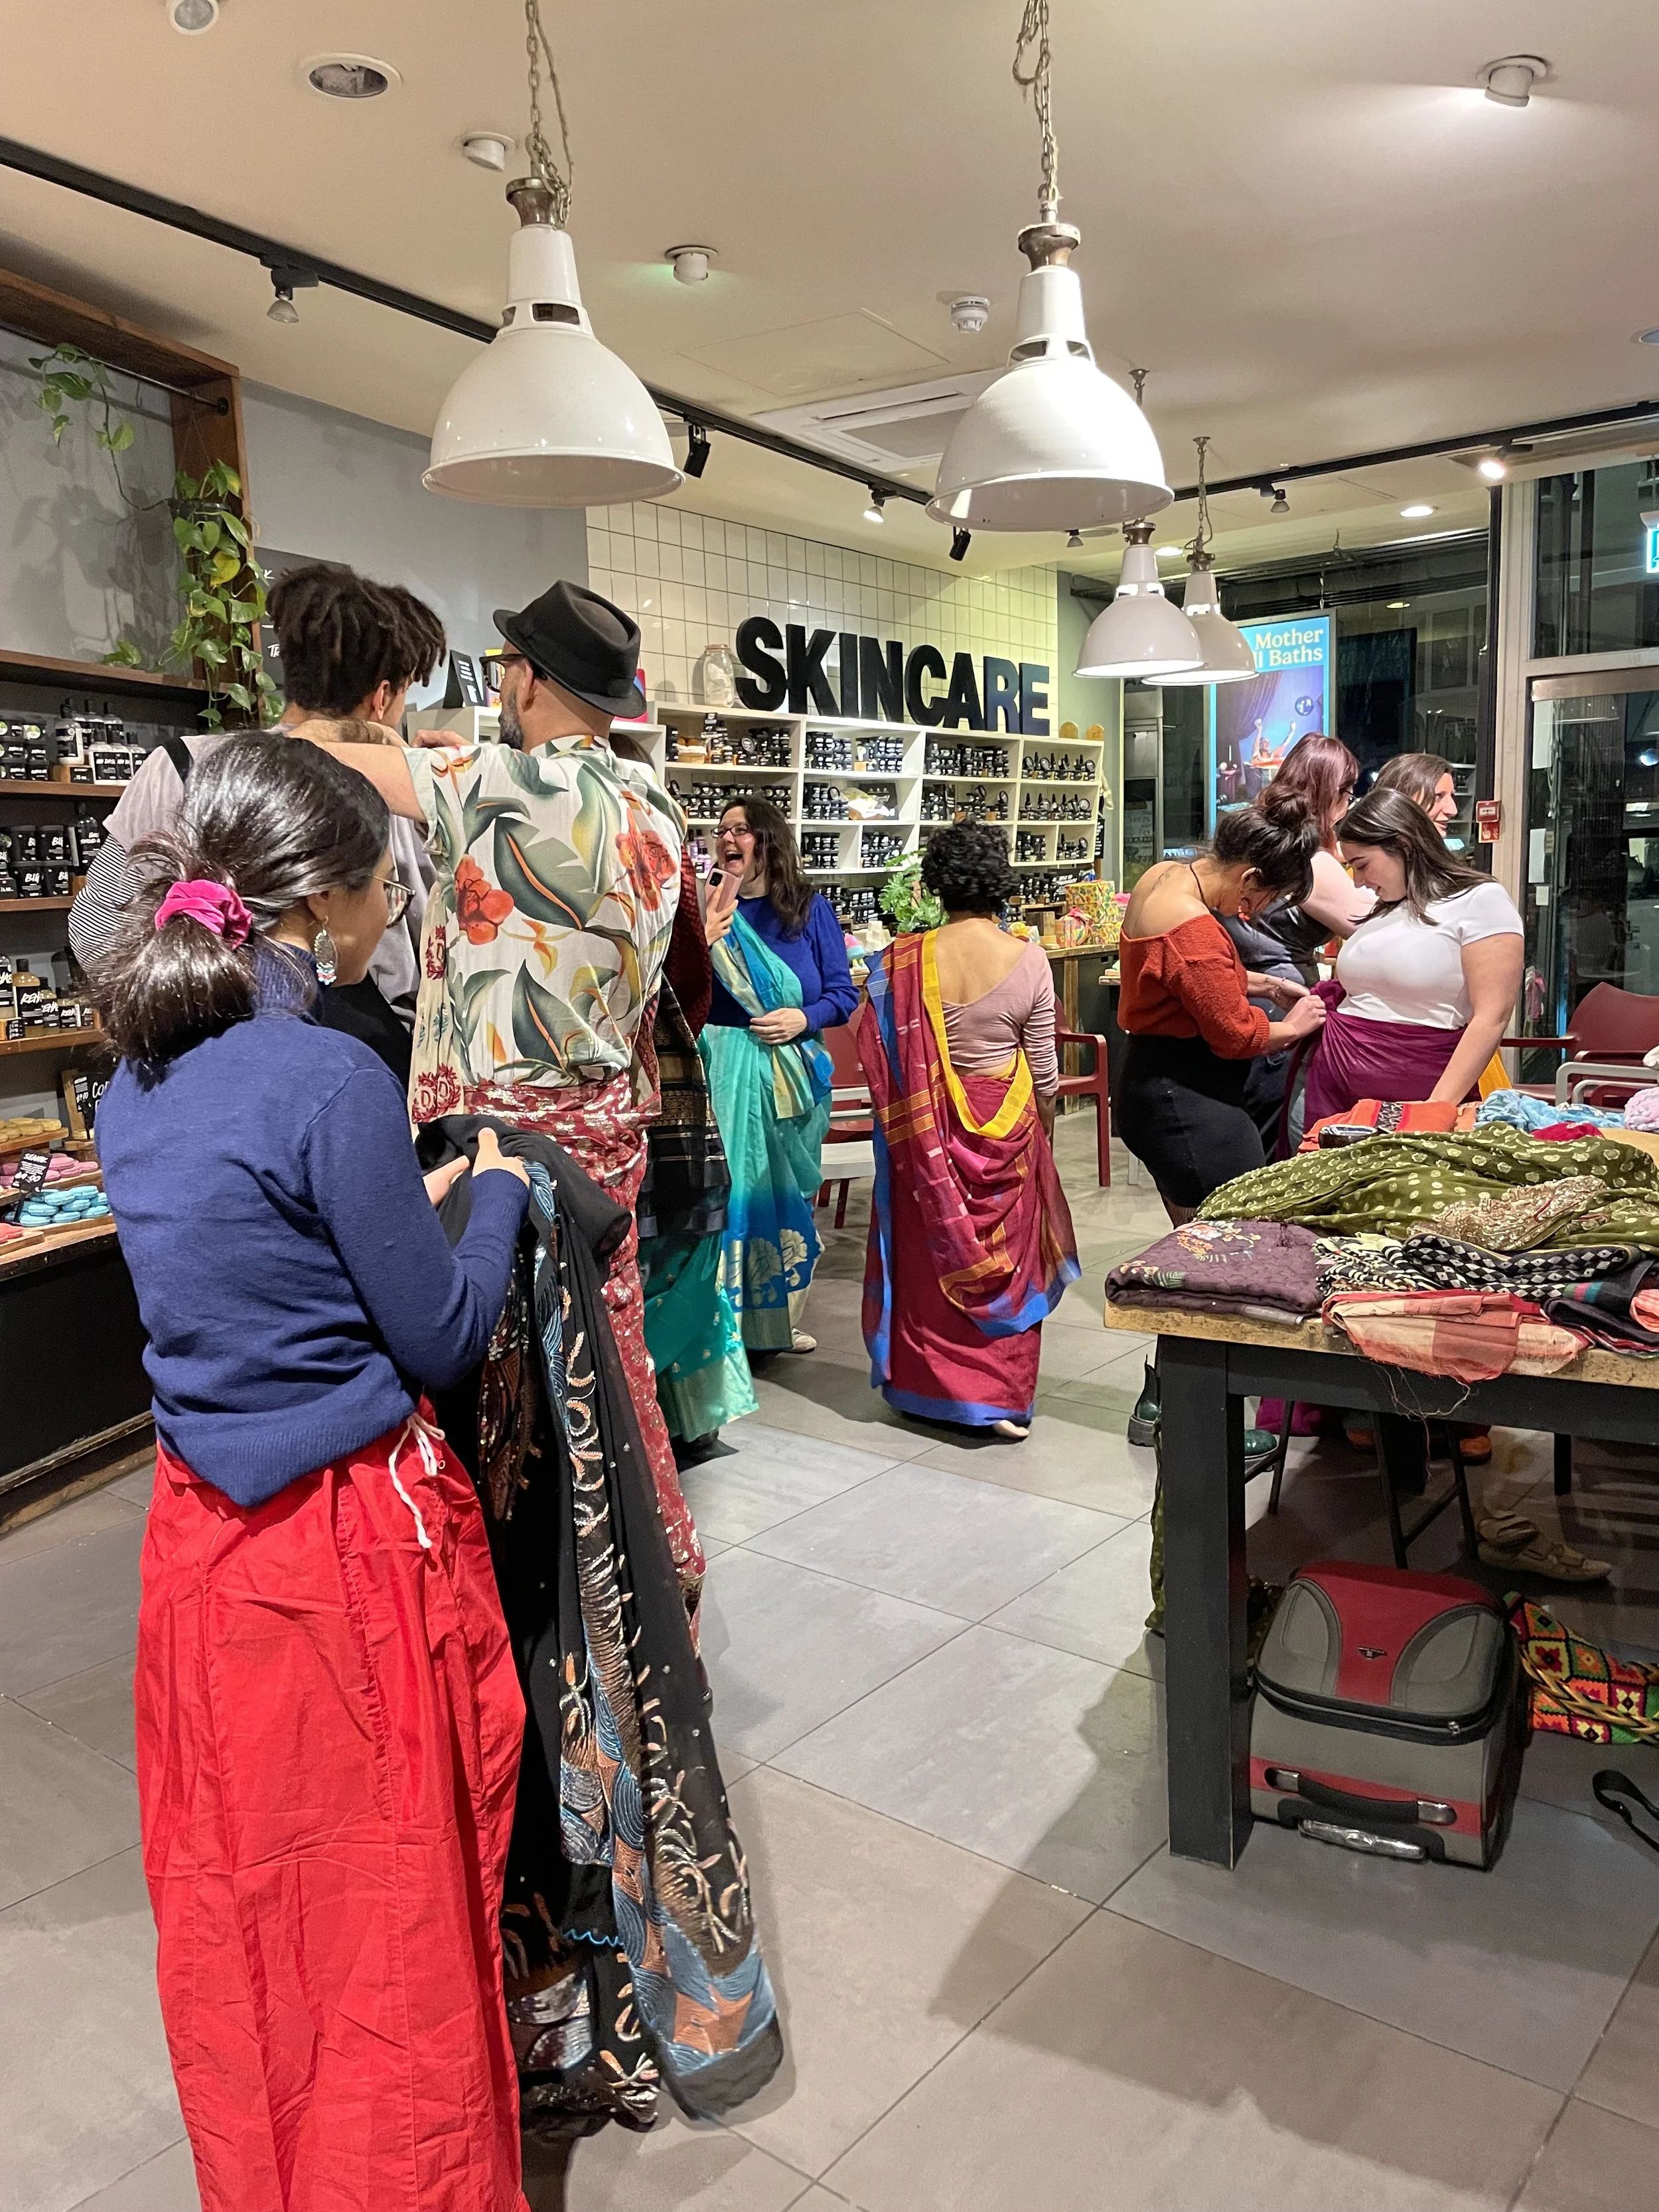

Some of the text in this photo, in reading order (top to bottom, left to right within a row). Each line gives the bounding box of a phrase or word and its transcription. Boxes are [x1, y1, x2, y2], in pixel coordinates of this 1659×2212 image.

[1255, 628, 1324, 650] Mother
[1268, 645, 1323, 667] Baths
[735, 616, 1050, 736] SKINCARE
